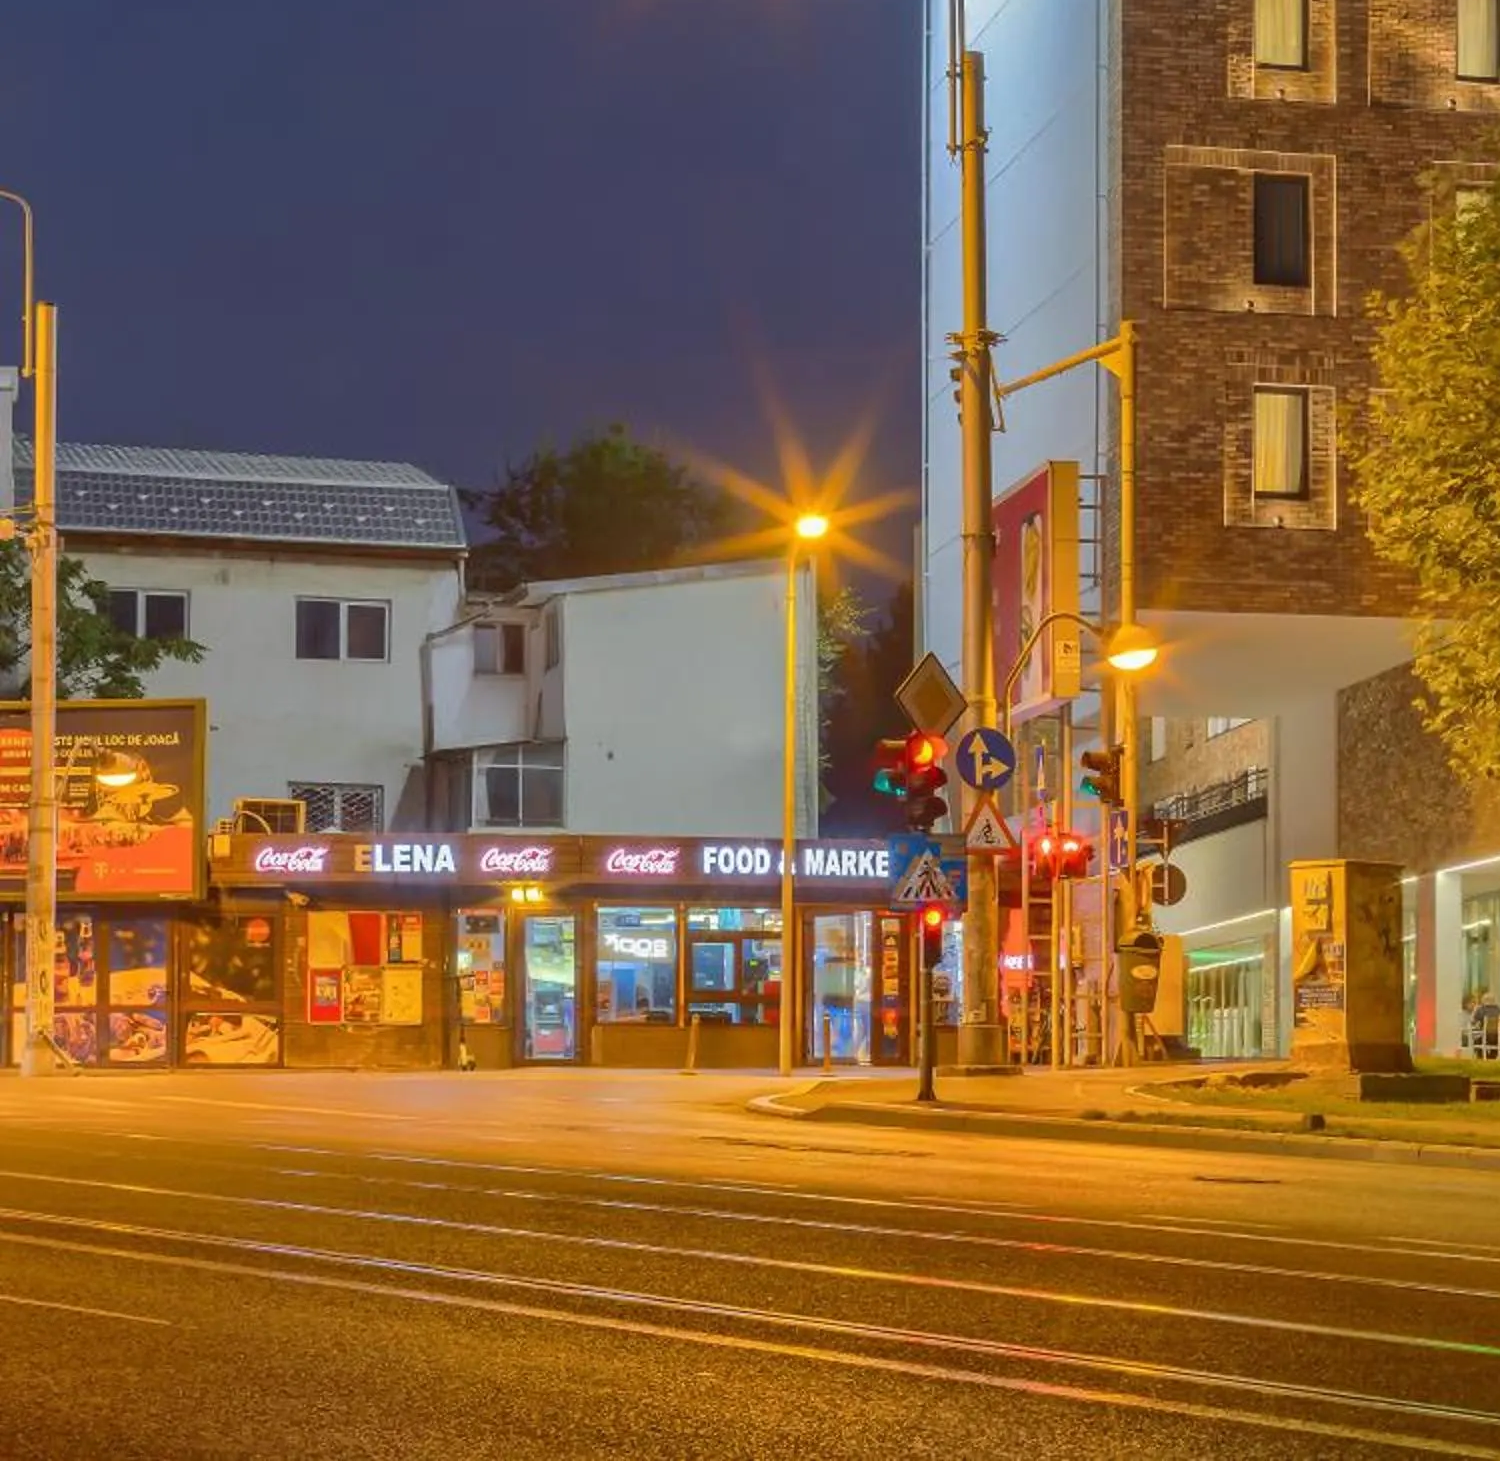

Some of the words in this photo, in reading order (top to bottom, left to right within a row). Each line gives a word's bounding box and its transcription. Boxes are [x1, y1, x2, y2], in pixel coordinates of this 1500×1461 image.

[127, 733, 142, 745] DE
[354, 844, 455, 872] ELENA
[703, 846, 770, 874] FOOD
[805, 848, 890, 877] MARKE
